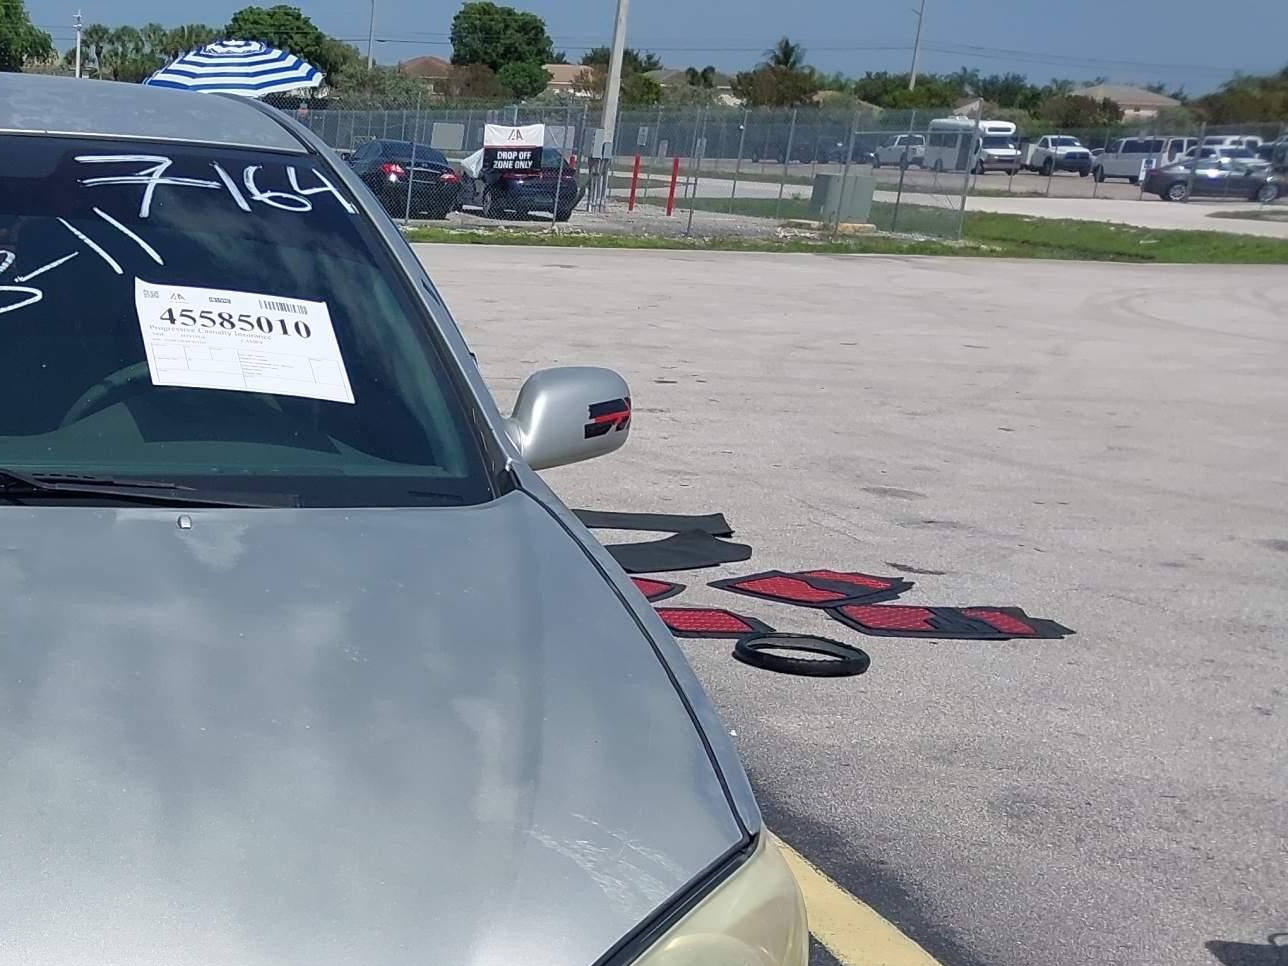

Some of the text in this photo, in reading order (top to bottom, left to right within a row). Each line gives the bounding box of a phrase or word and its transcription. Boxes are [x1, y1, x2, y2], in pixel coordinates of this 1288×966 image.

[497, 151, 532, 160] DROP OFF
[493, 160, 533, 169] ZONE ONLY
[159, 307, 312, 339] 45585010
